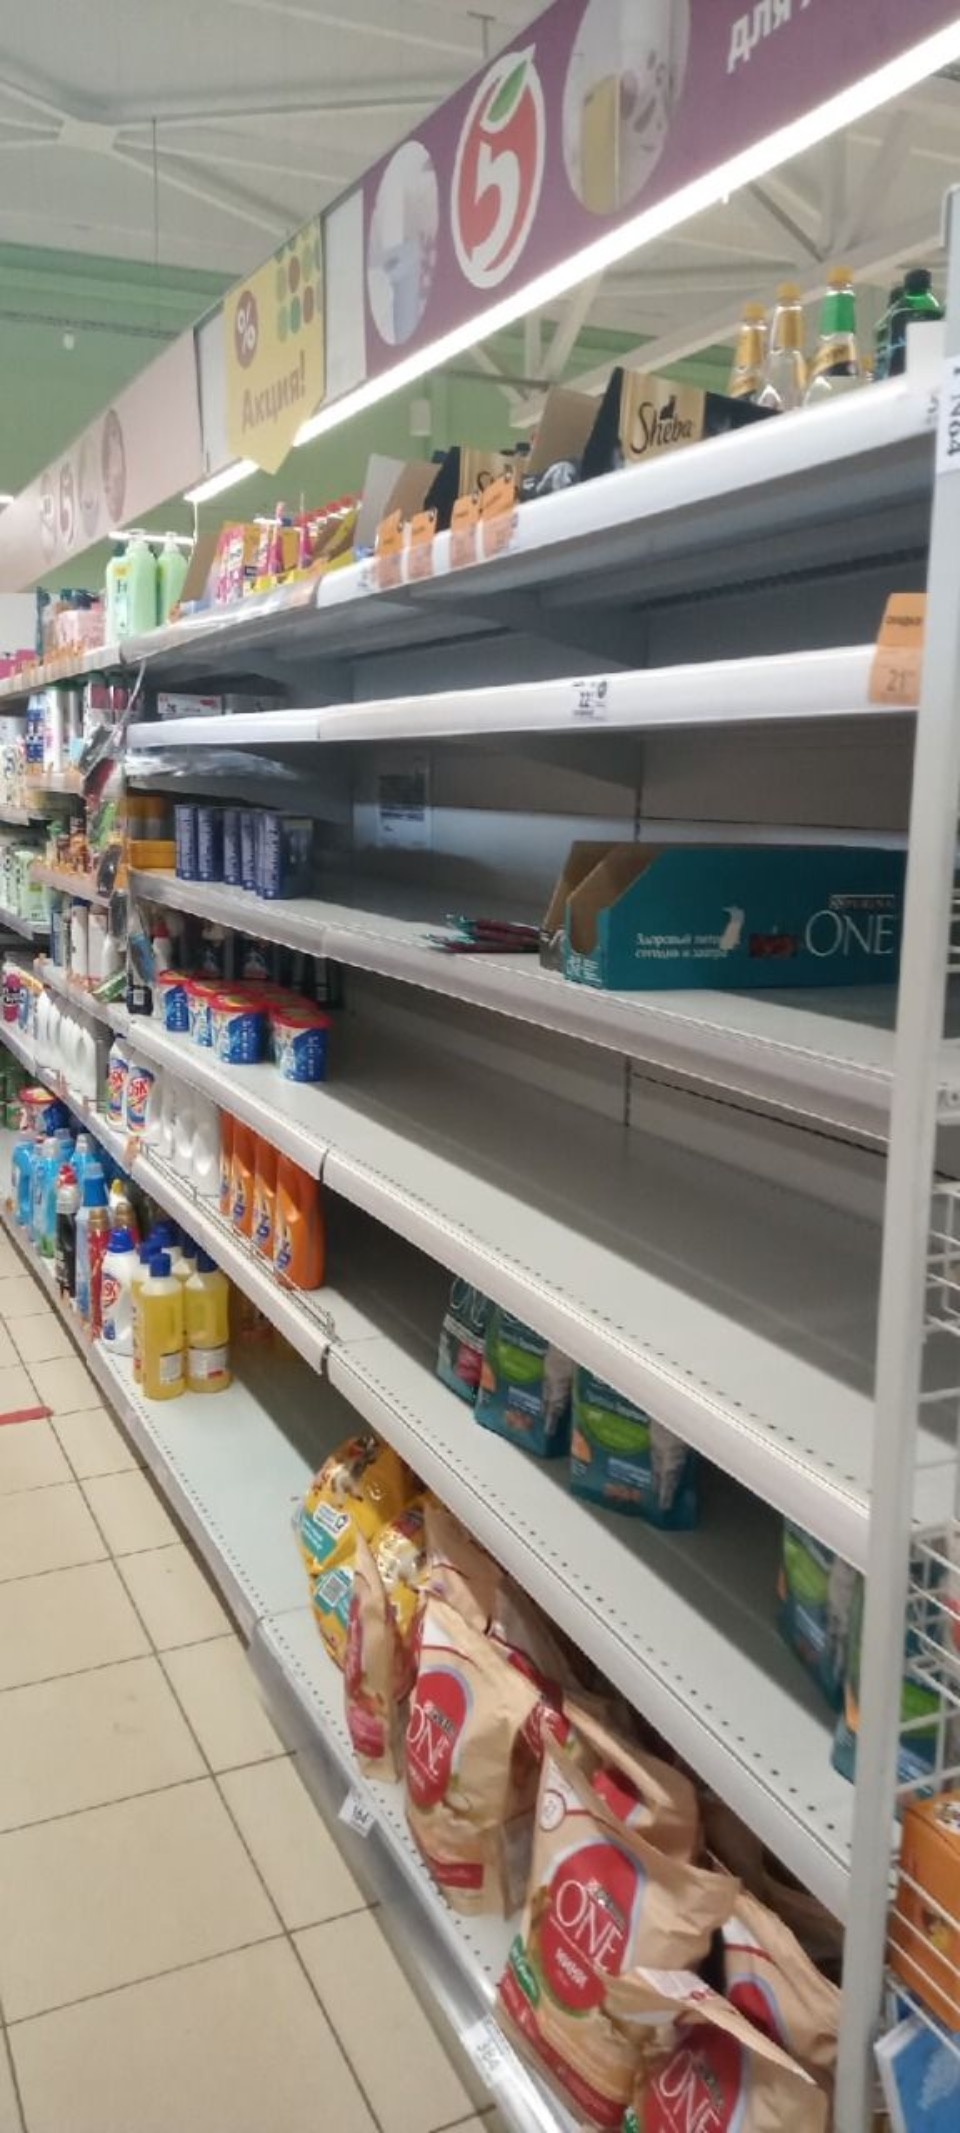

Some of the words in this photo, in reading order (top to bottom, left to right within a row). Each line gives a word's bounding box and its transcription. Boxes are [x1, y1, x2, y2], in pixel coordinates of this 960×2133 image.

[243, 349, 306, 435] Акция!
[630, 401, 692, 454] Sheba
[806, 910, 895, 957] ONE
[557, 1880, 623, 1972] ONE
[660, 2049, 721, 2133] ONE
